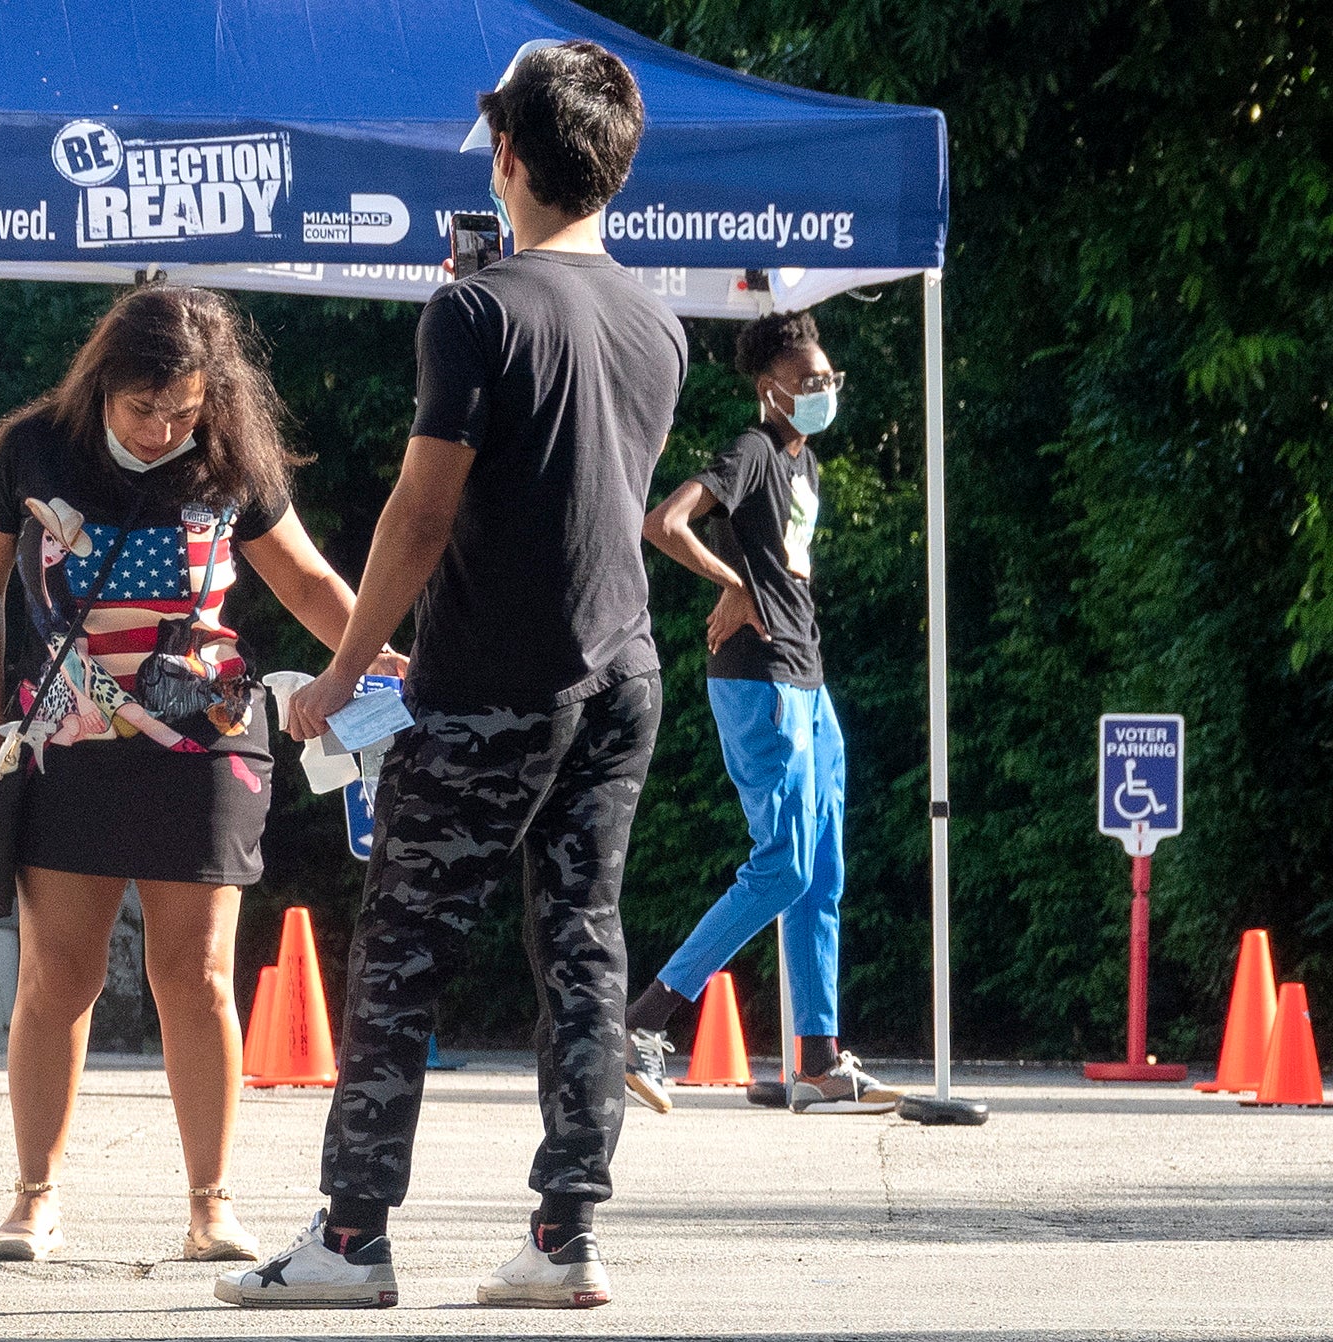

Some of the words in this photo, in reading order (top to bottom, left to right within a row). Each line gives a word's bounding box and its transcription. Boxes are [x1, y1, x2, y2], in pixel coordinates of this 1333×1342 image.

[62, 130, 115, 175] BE
[126, 142, 282, 186] ELECTION
[87, 180, 282, 239] READY
[304, 229, 348, 239] COUNTY
[1115, 727, 1167, 742] VOTER
[1107, 742, 1176, 757] PARKING
